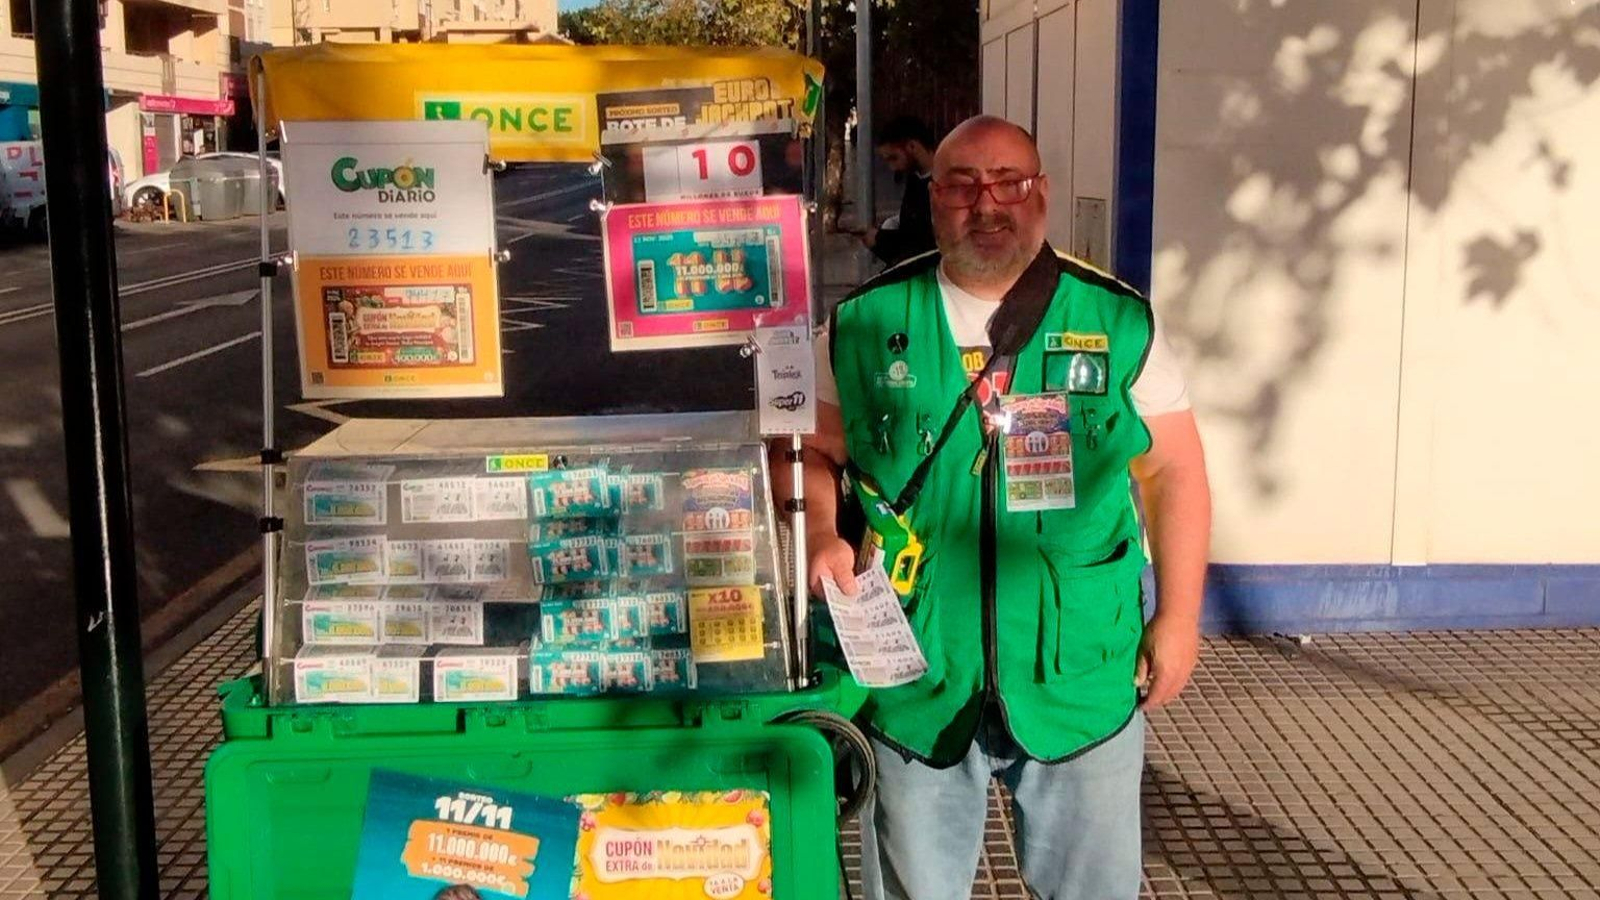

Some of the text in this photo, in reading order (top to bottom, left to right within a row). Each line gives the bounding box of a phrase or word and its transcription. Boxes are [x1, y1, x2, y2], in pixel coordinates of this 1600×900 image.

[470, 107, 573, 132] ONCE
[606, 116, 687, 133] BOTE DE
[331, 157, 435, 192] CUPÓN
[334, 212, 349, 220] Este
[628, 213, 655, 229] ESTE
[656, 209, 700, 226] NÚMERO
[703, 209, 717, 223] SE
[719, 206, 754, 222] VENDE
[348, 227, 434, 250] 23513
[320, 266, 345, 280] ESTE
[347, 264, 393, 280] NÚMERO
[395, 265, 408, 279] SE
[409, 264, 447, 279] VENDE
[1063, 336, 1106, 348] ONCE
[505, 459, 545, 468] ONCE
[434, 796, 513, 830] 11/11
[605, 837, 652, 857] CUPÓN
[605, 860, 639, 872] EXTRA
